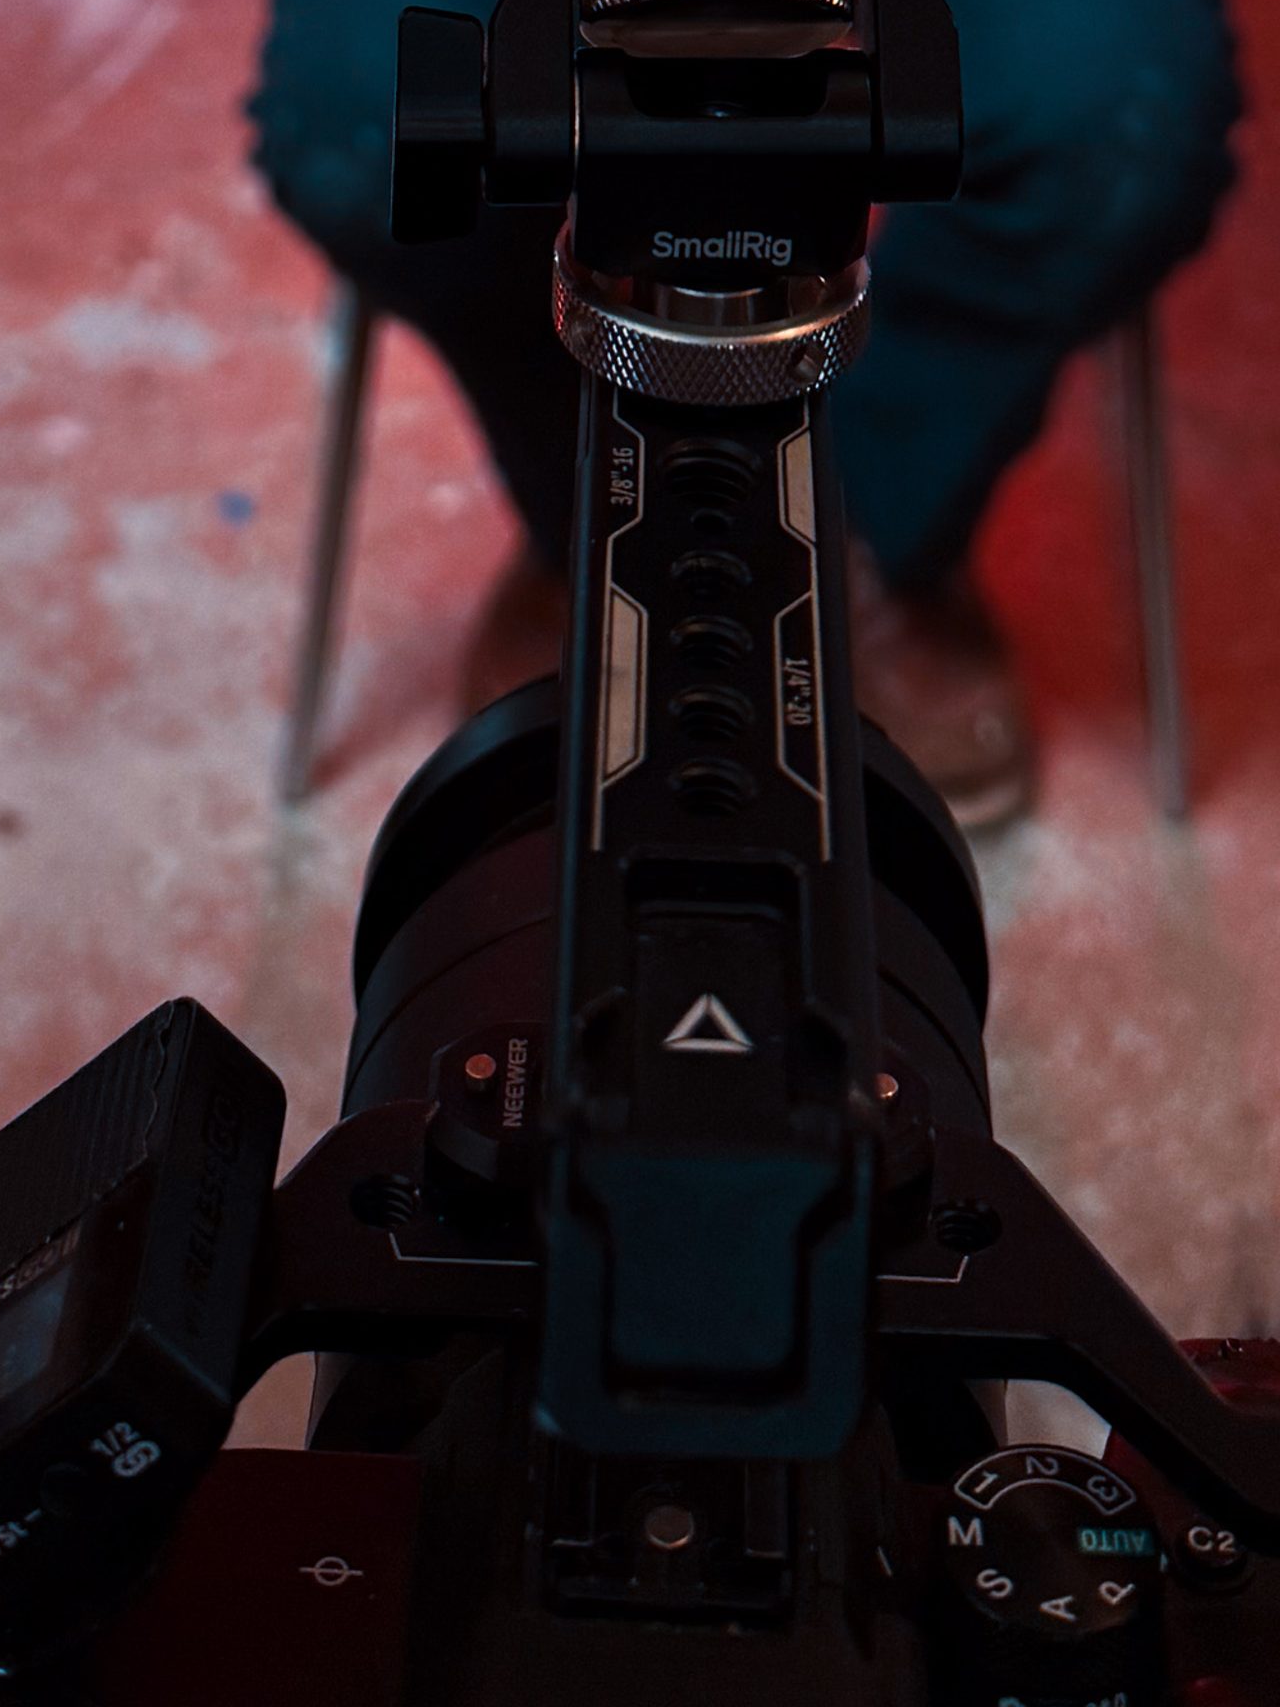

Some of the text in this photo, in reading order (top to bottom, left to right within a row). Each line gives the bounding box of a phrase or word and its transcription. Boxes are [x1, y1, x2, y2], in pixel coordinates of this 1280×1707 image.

[651, 230, 793, 266] SmallRig
[502, 1037, 528, 1129] NEEWER
[947, 1515, 985, 1547] M
[1080, 1528, 1150, 1555] AUTO
[1187, 1524, 1236, 1556] C2
[976, 1567, 1016, 1600] S
[1039, 1593, 1079, 1625] A
